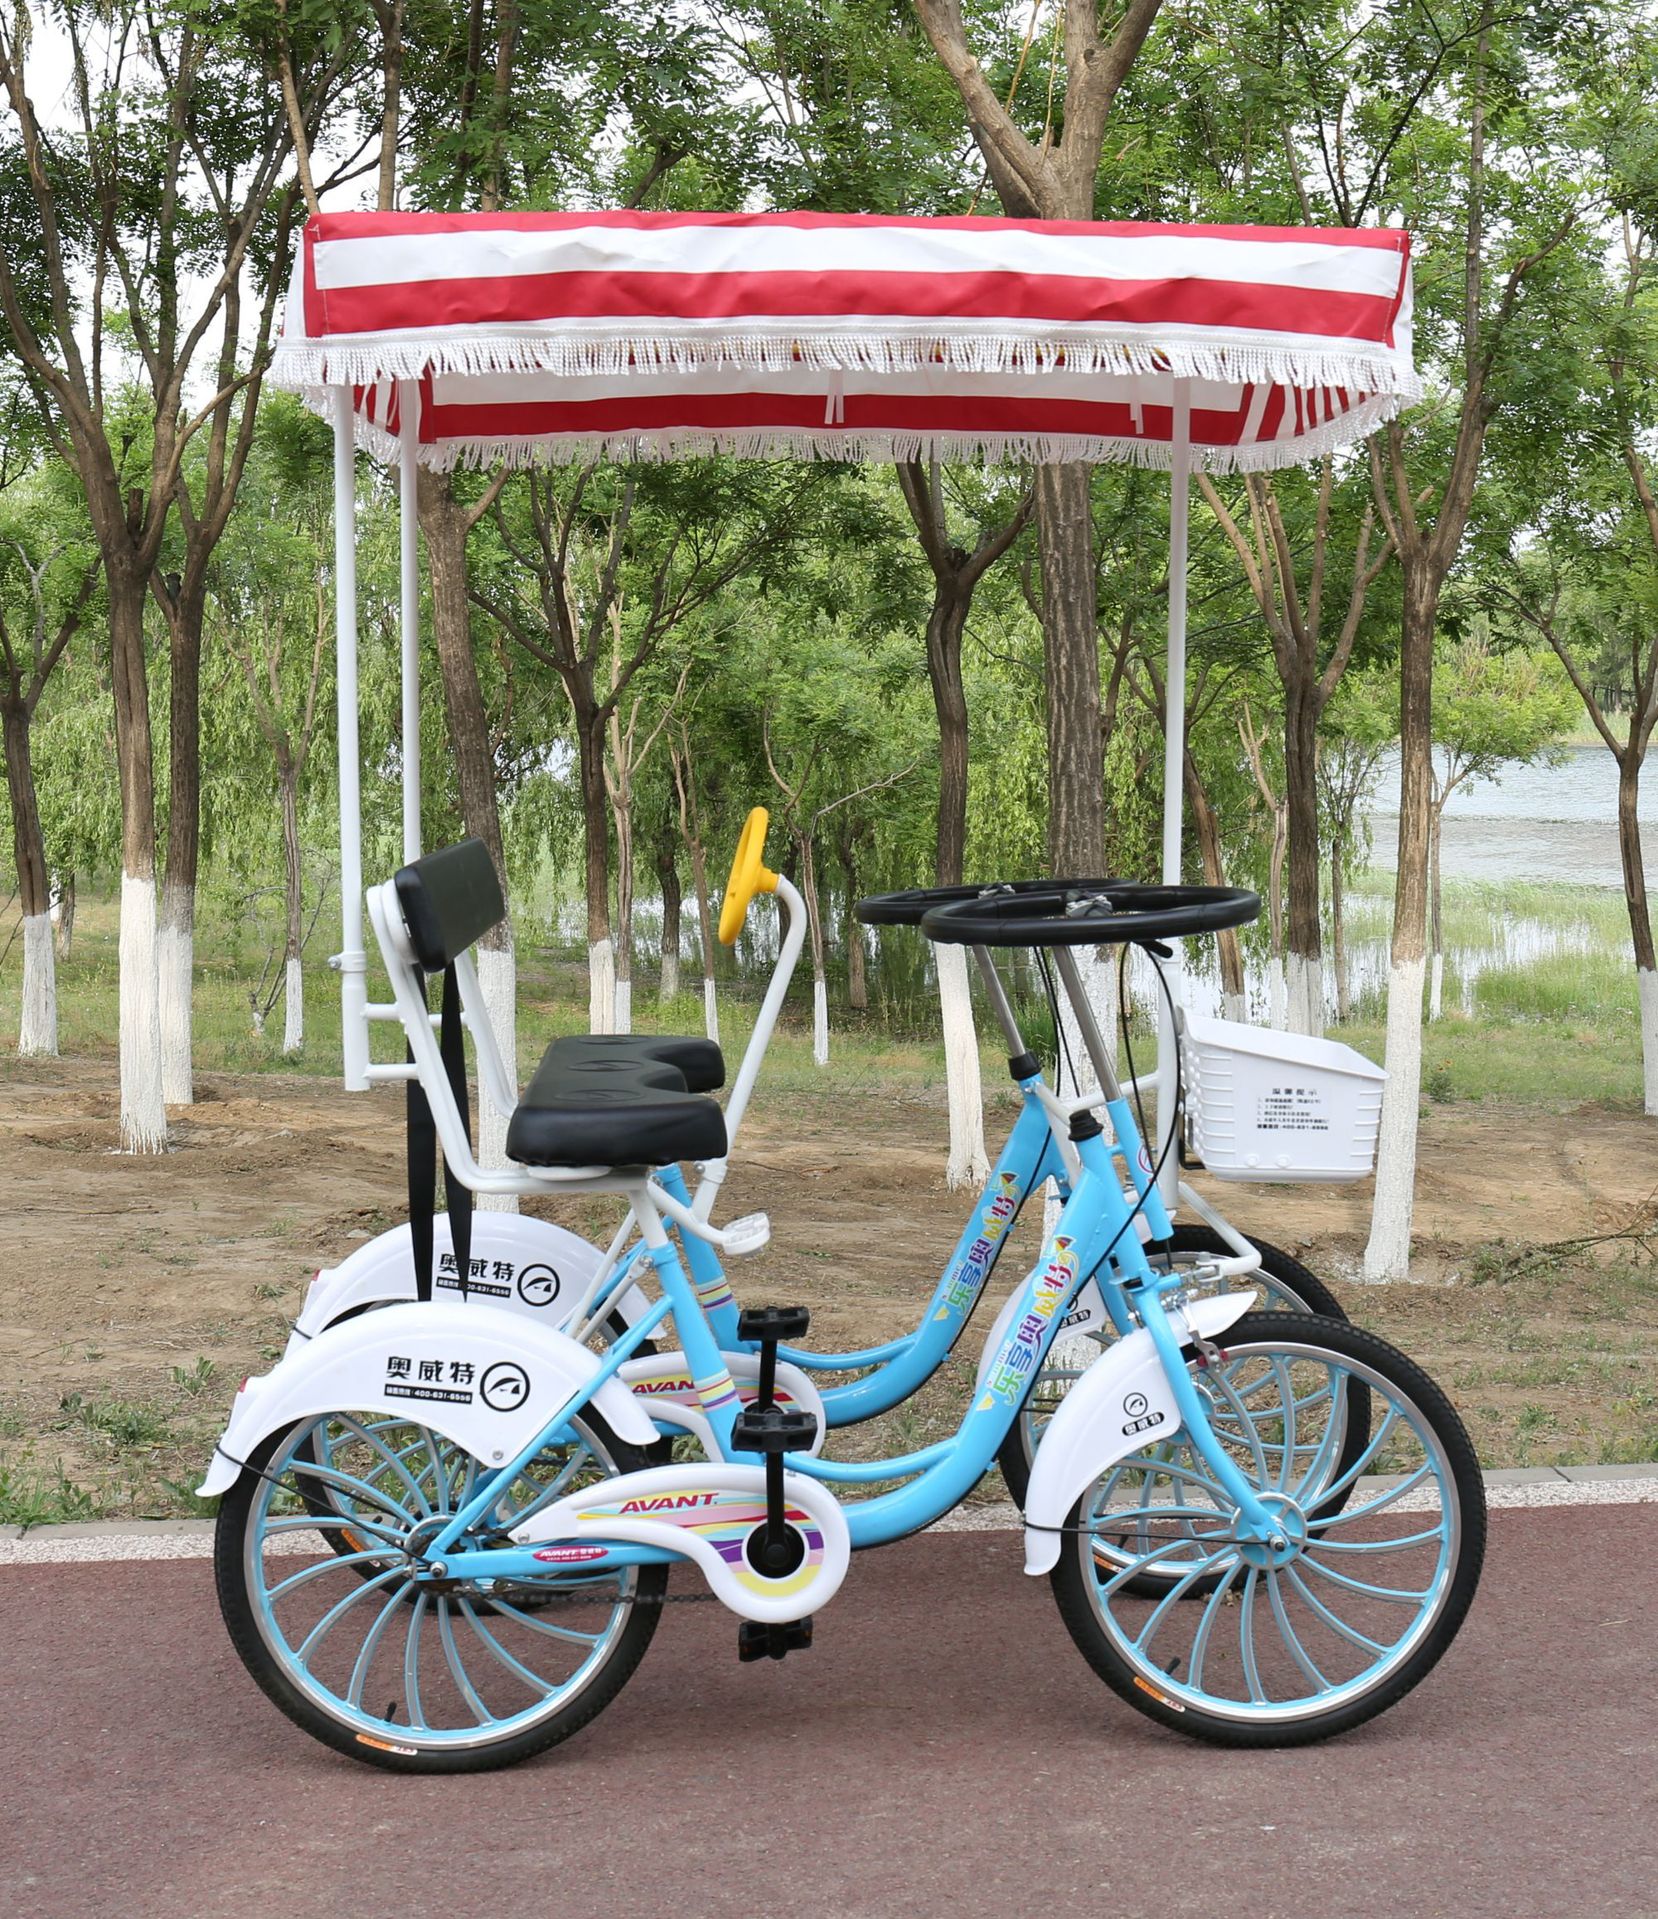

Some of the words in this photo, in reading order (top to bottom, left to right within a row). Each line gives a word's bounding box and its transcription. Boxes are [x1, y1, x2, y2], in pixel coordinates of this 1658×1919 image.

[438, 1253, 516, 1282] 奥威特
[947, 1195, 1016, 1315] 乐享奥威特
[993, 1263, 1073, 1406] 乐享奥威特
[386, 1355, 476, 1385] 奥威特
[631, 1380, 696, 1394] AVAN
